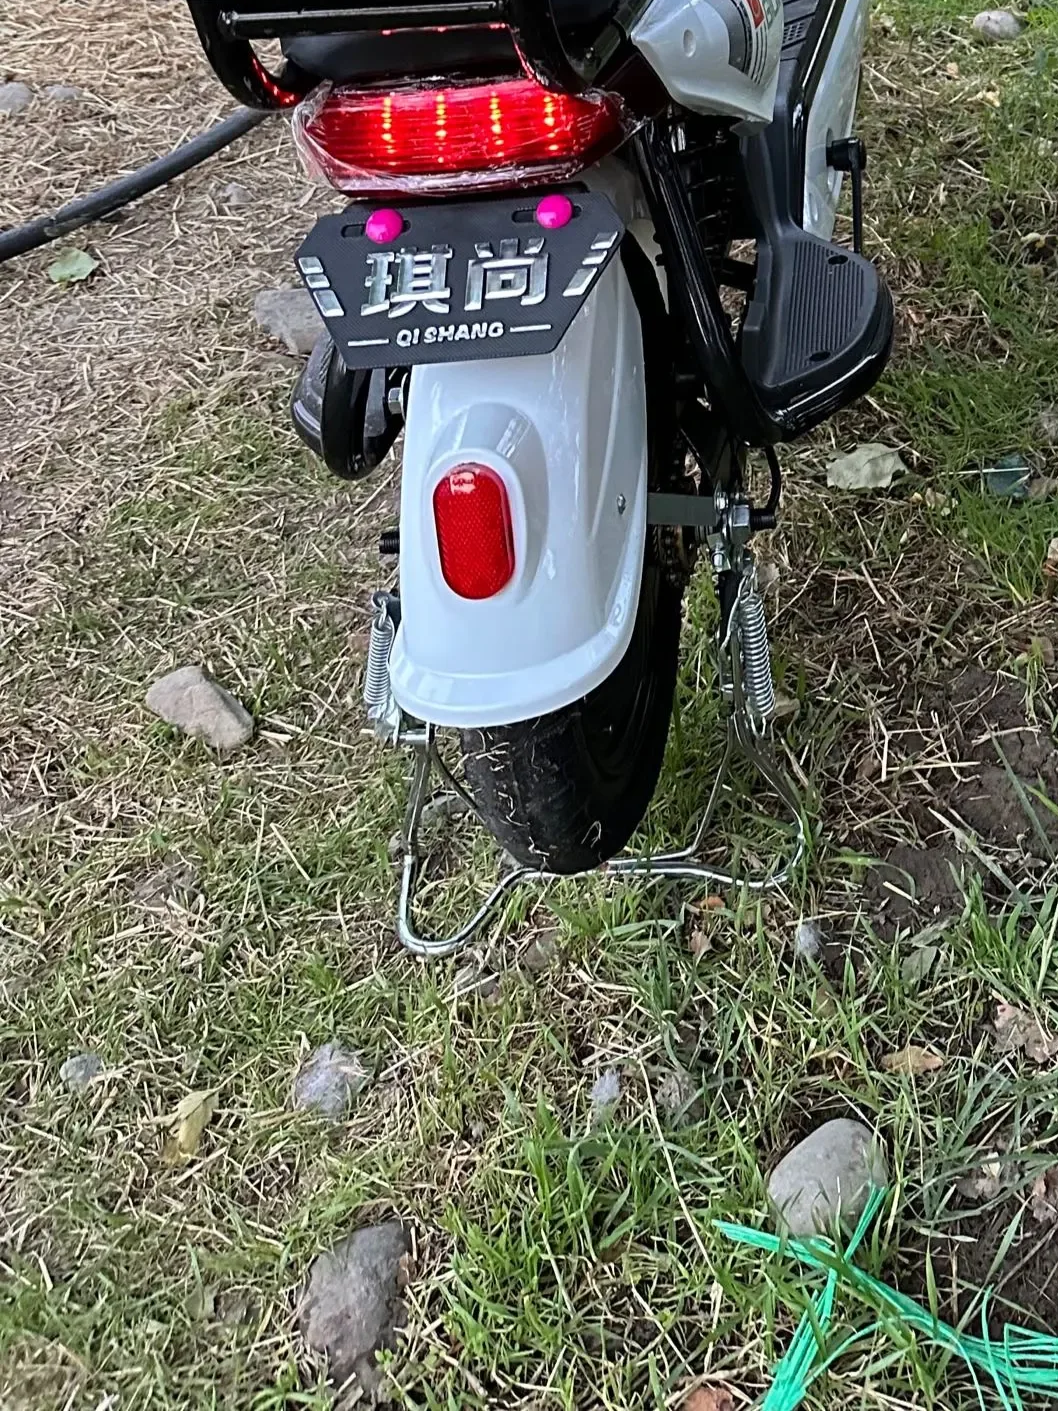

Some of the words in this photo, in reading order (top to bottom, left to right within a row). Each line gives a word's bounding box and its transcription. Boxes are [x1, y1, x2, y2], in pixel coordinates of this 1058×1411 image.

[360, 237, 550, 319] 琪尚
[395, 329, 420, 348] QI
[423, 322, 505, 345] SHANG
